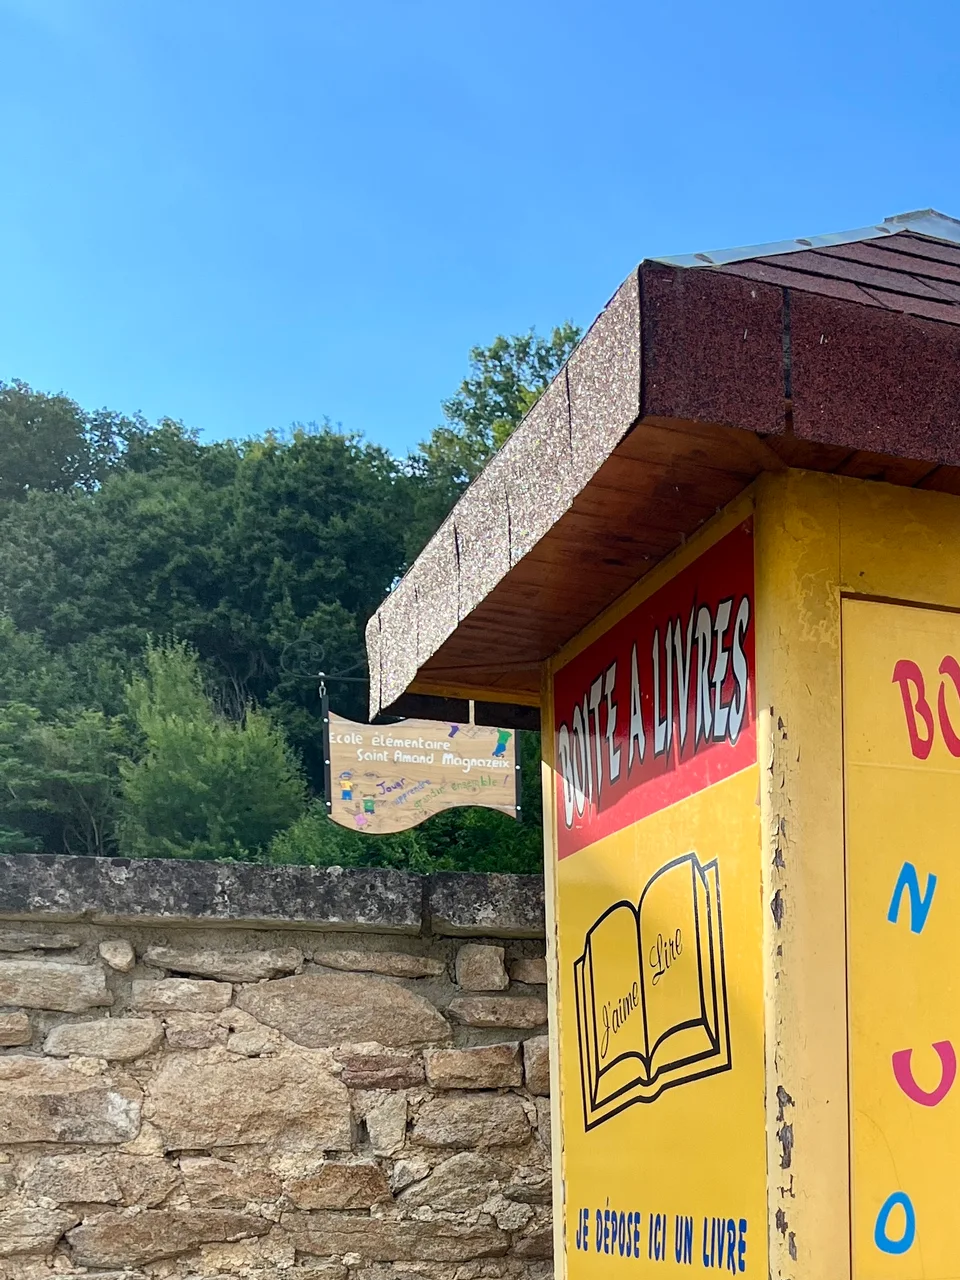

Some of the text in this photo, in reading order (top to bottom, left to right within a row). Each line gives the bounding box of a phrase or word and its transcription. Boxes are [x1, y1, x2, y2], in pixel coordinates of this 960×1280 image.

[329, 733, 450, 750] Ecole élémentaire
[559, 596, 749, 830] BOITE A LIVRES
[357, 749, 510, 773] Saint Amand Magnazeix
[887, 861, 937, 934] N
[600, 928, 683, 1059] J'aime Lire
[576, 1197, 747, 1275] JE DÉPOSE ICI UN LIVRE
[874, 1191, 916, 1255] O
